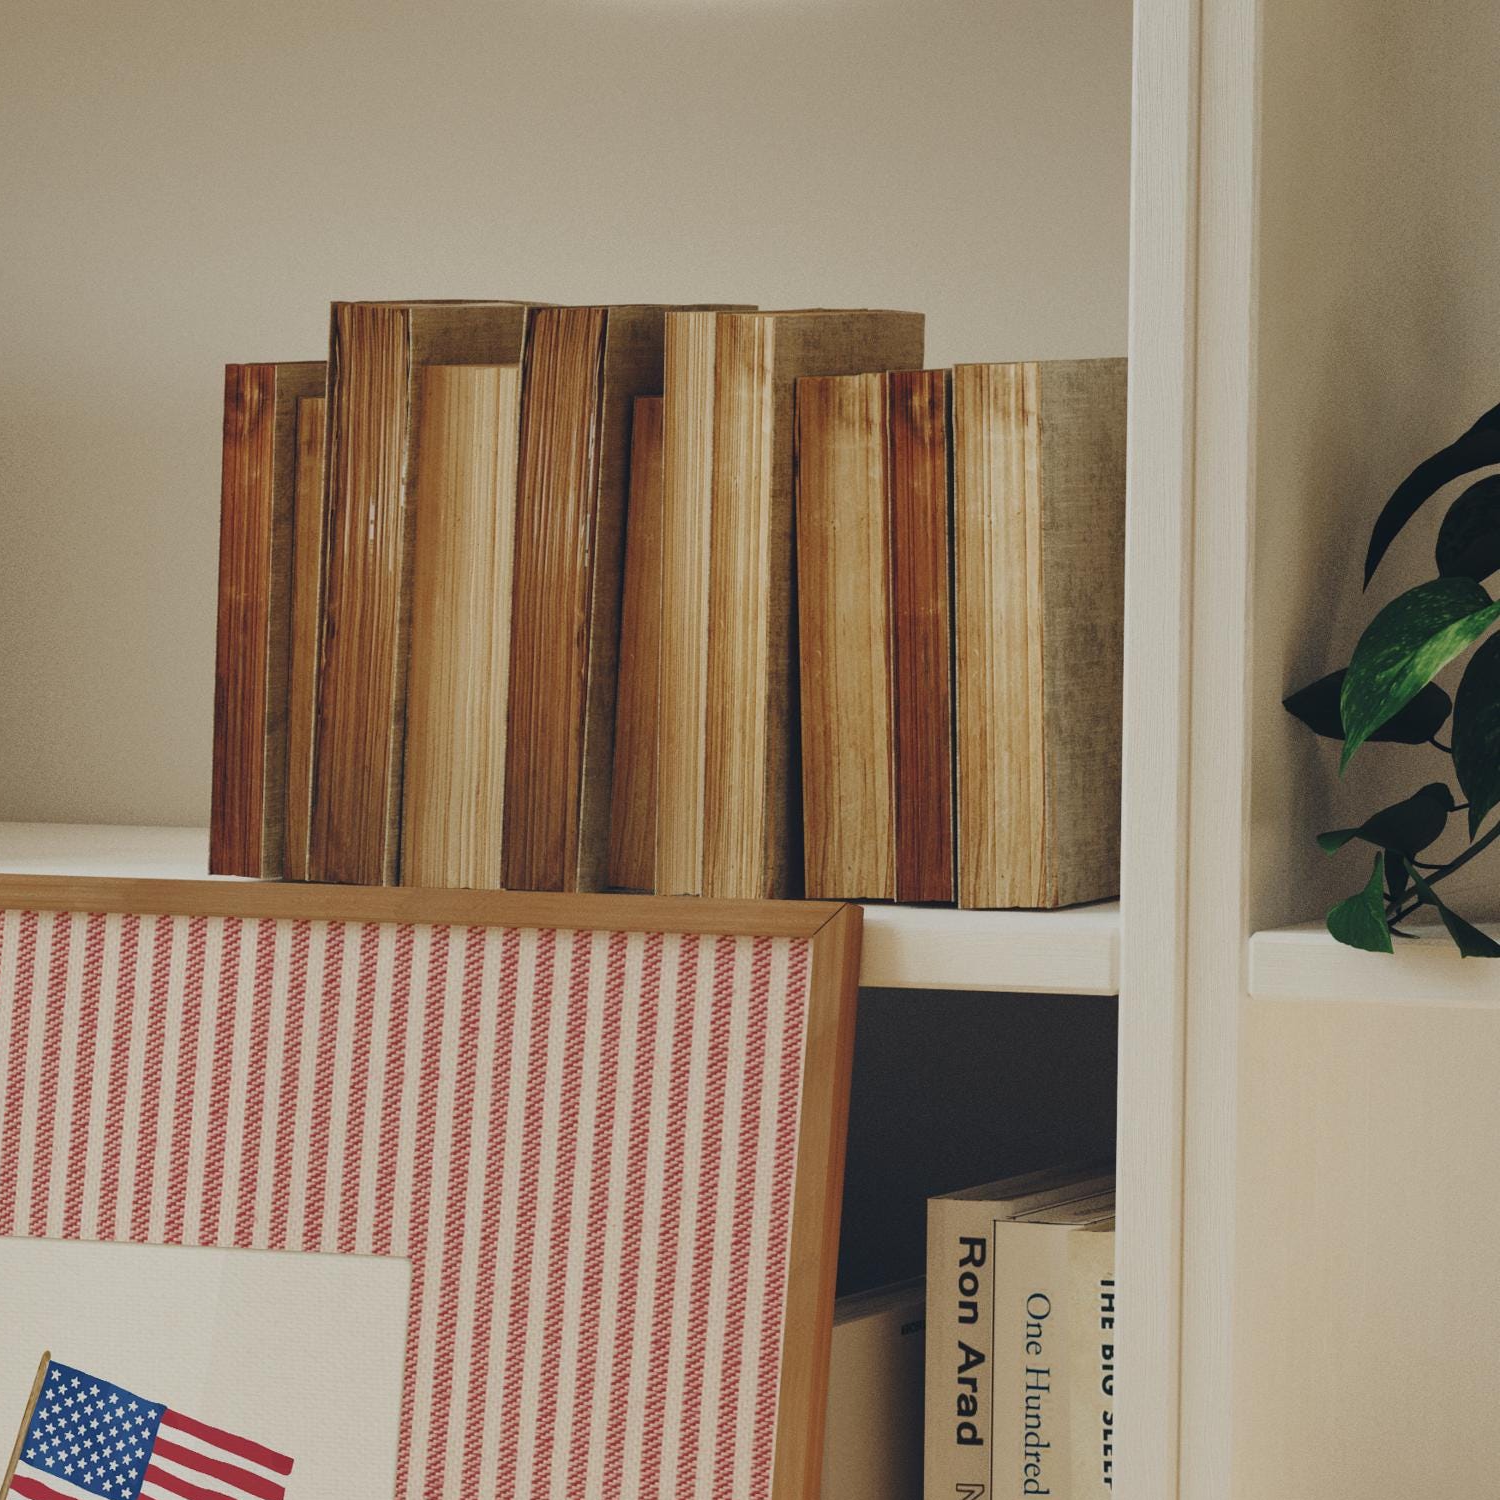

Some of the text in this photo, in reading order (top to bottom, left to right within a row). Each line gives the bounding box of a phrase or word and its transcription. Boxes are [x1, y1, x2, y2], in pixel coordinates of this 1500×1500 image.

[958, 1236, 986, 1325] Ron
[1026, 1292, 1051, 1355] One
[956, 1340, 986, 1446] Arad
[1023, 1367, 1050, 1495] Hundred
